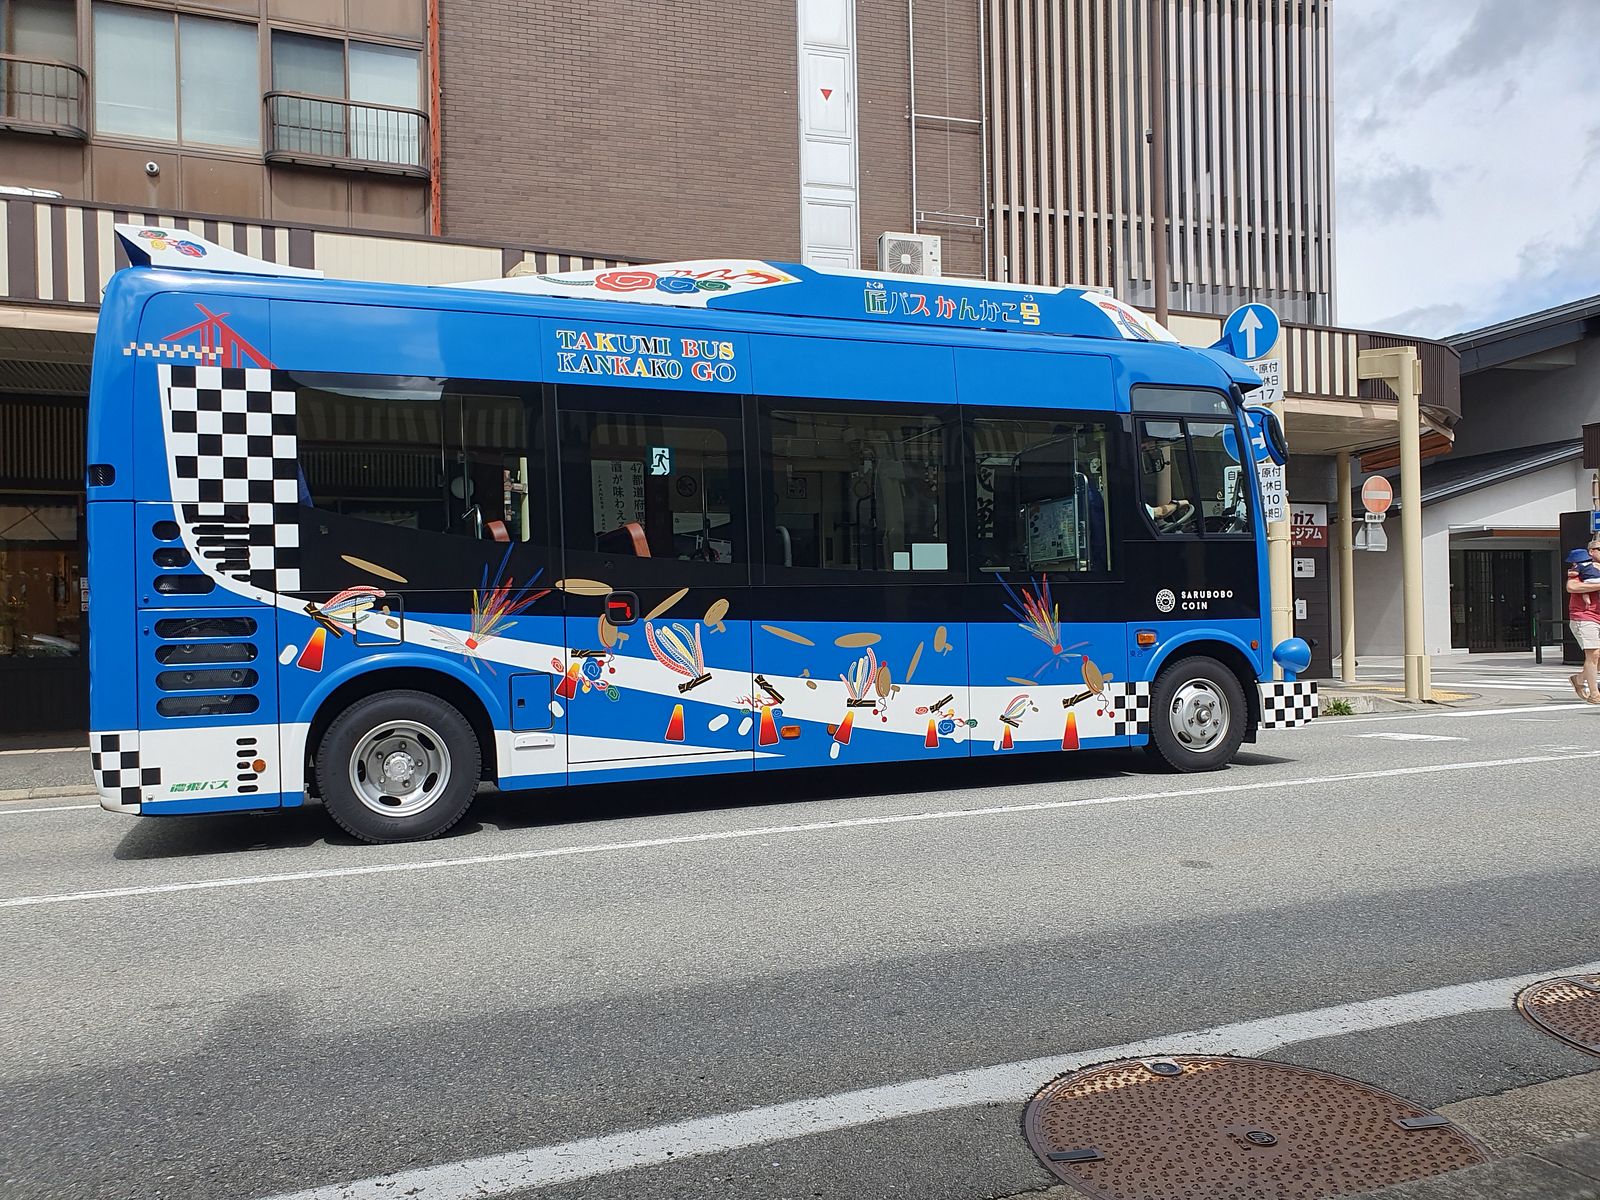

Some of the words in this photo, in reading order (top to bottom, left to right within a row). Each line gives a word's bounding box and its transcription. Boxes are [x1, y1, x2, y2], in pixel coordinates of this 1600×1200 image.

[556, 330, 672, 357] TAKUMI
[681, 338, 735, 361] BUS
[557, 352, 683, 380] KANKAKO
[691, 361, 737, 383] GO
[1291, 510, 1315, 525] ガス
[1181, 590, 1234, 600] SARUBOBO
[1181, 601, 1208, 610] COIN
